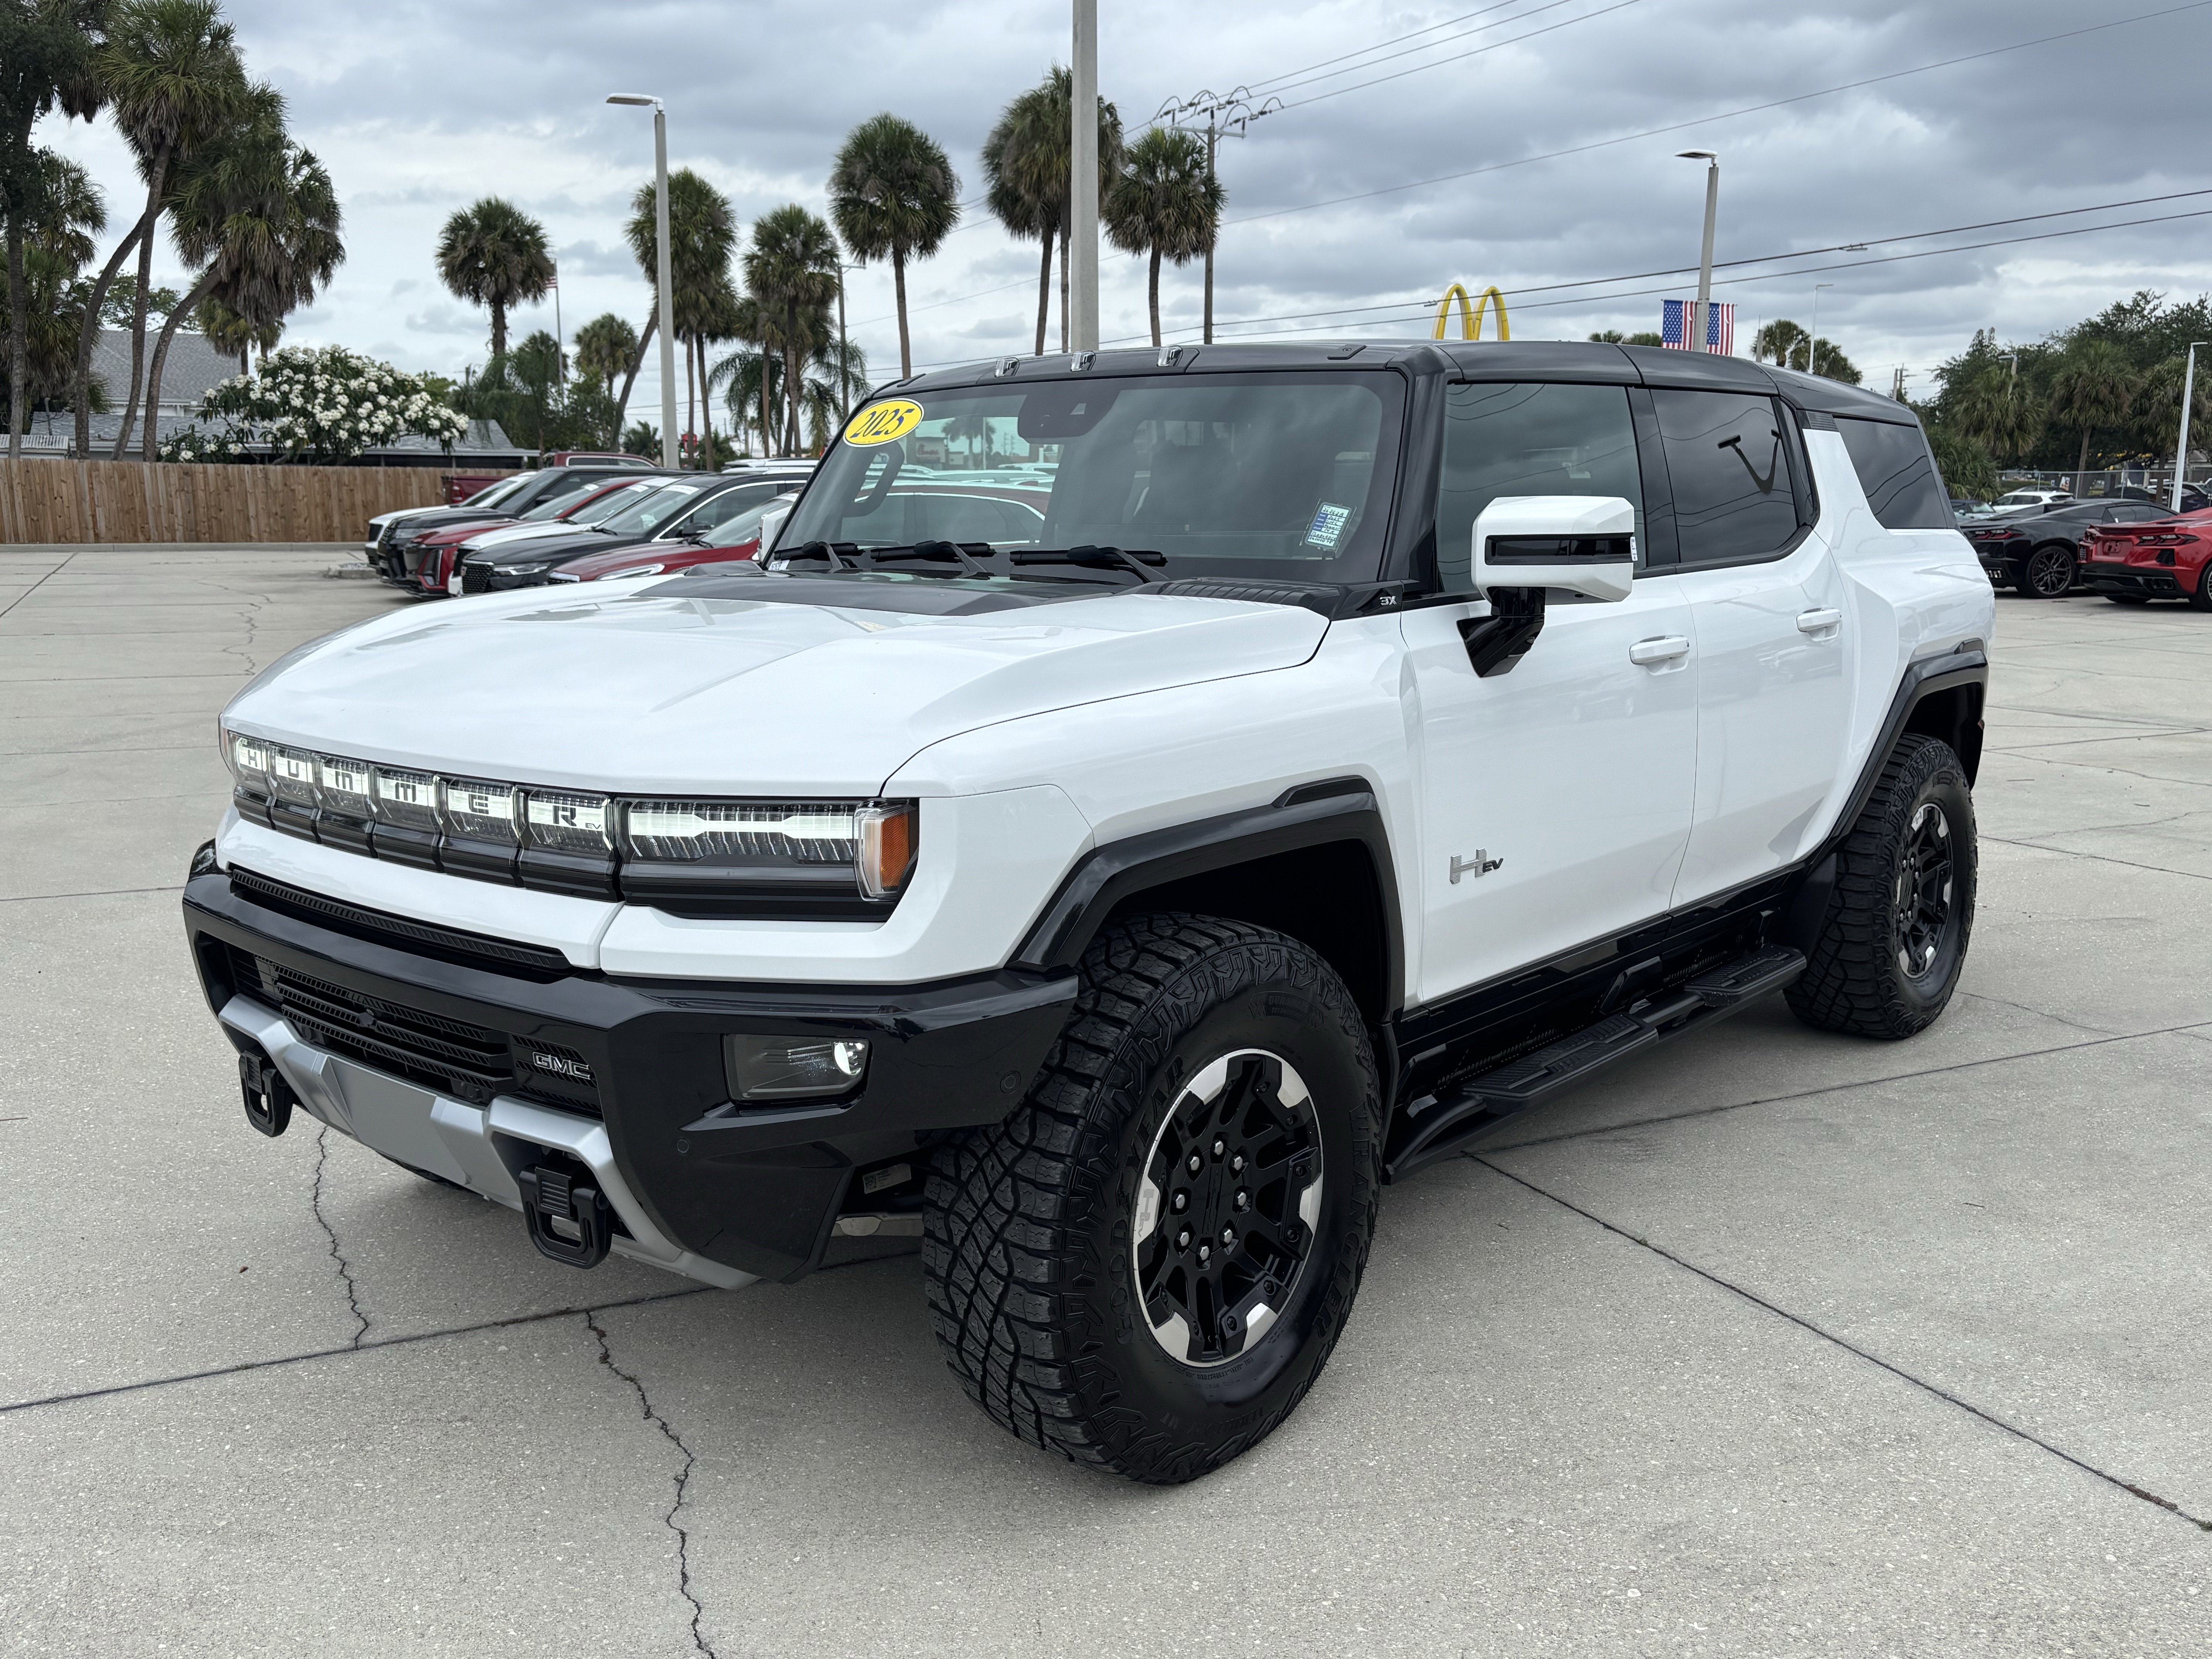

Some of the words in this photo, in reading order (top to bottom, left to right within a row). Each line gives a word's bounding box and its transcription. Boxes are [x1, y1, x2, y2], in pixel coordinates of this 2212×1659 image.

[850, 408, 915, 438] 2025
[1380, 596, 1397, 606] 3X
[248, 749, 577, 827] HUMMER
[1482, 858, 1504, 873] EV
[1268, 996, 1310, 1013] DURA
[532, 1052, 591, 1080] GMC
[1312, 1101, 1370, 1338] WRANGLER
